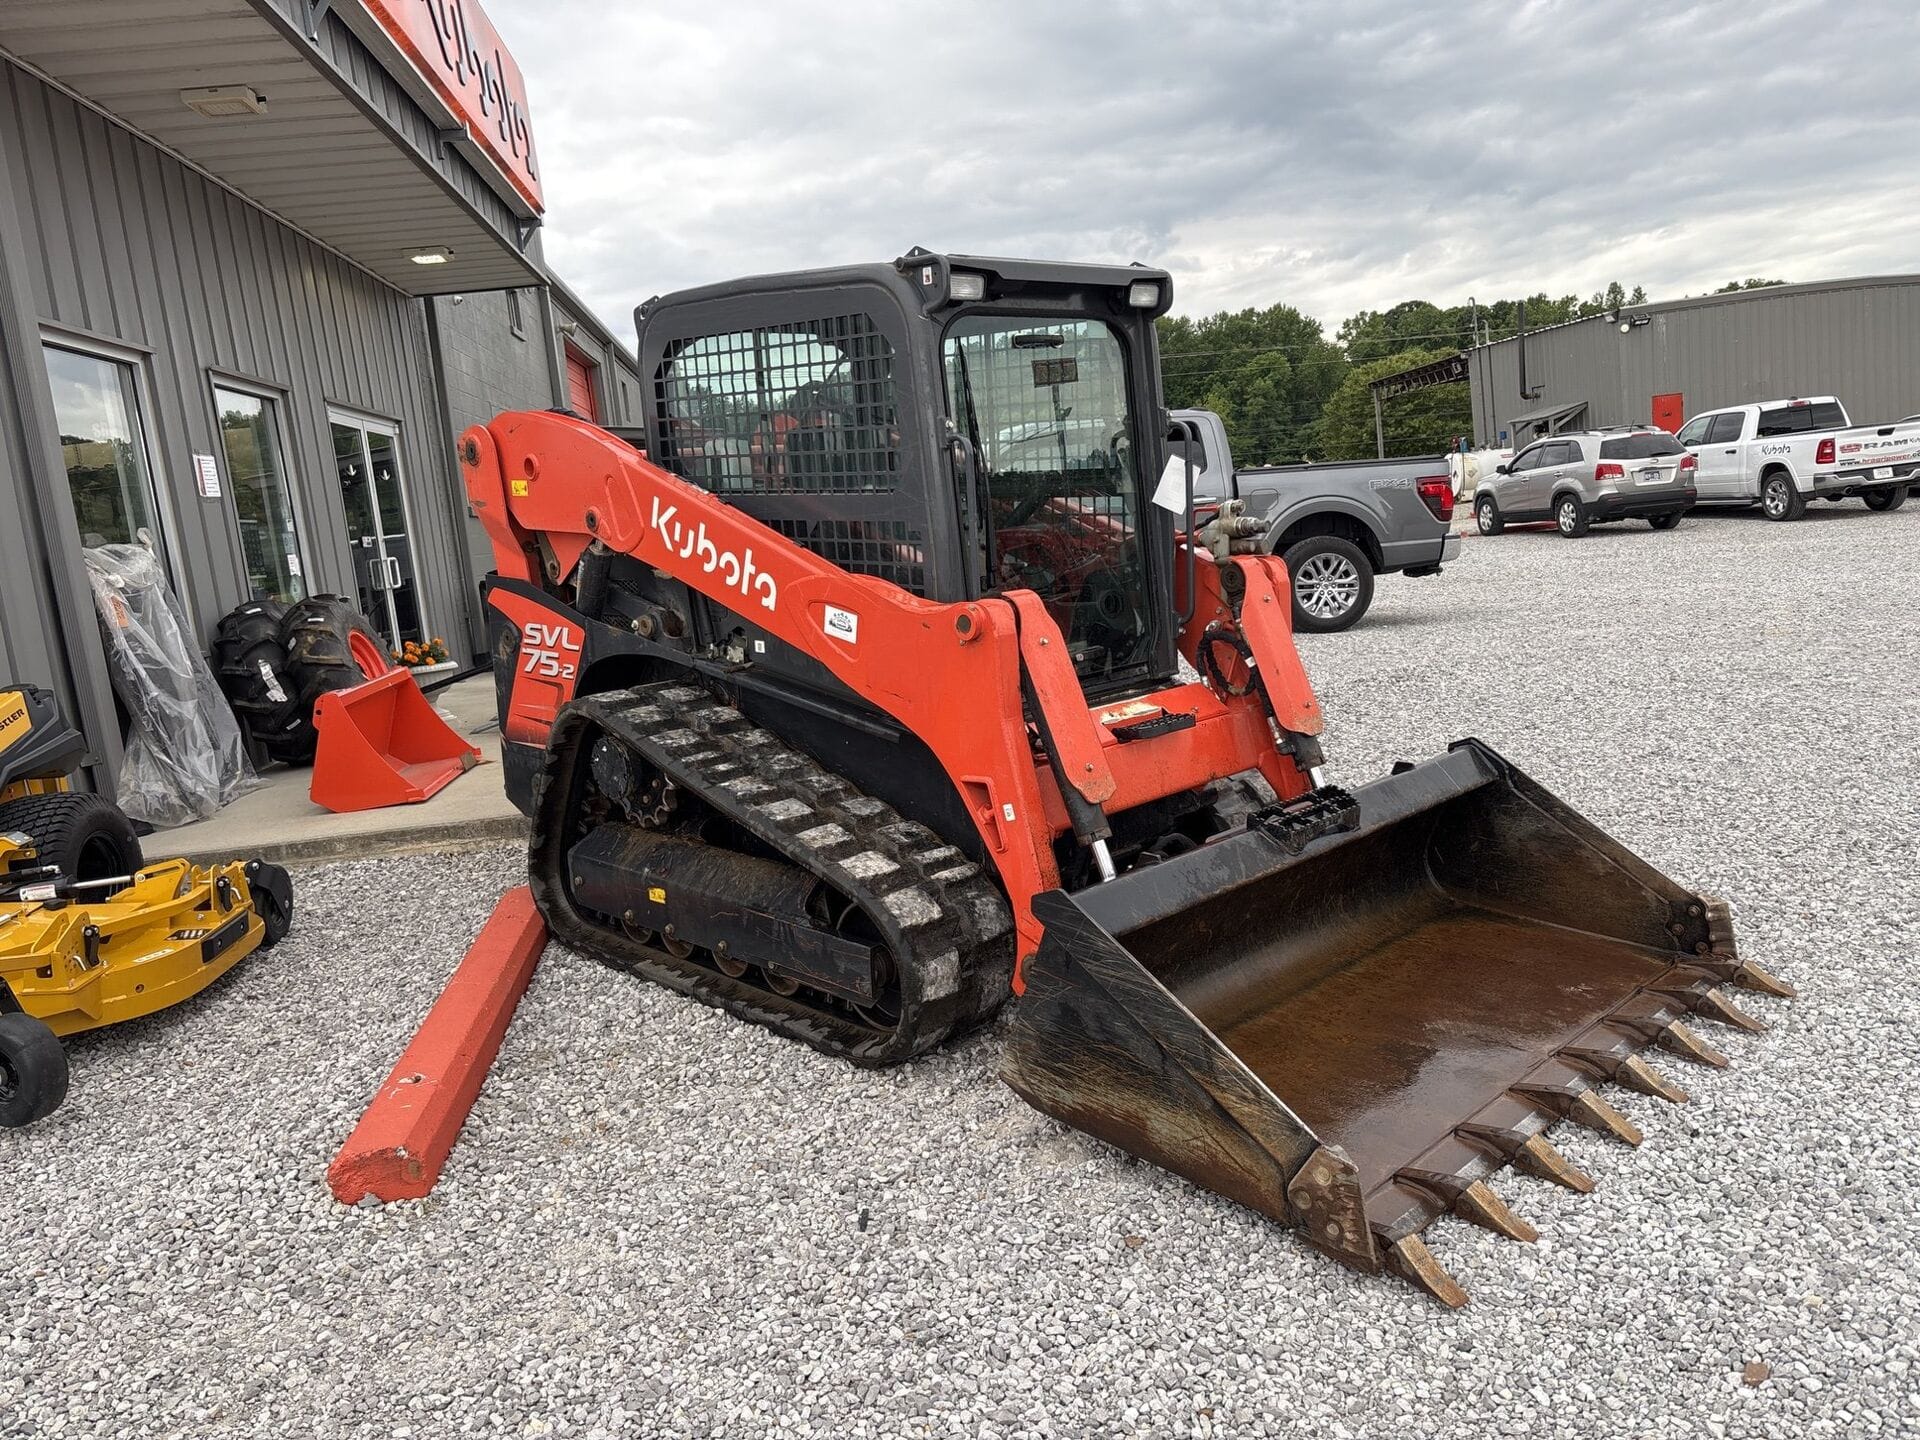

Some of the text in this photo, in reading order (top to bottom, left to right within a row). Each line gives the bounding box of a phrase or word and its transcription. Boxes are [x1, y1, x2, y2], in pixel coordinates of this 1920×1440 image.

[1761, 443, 1792, 456] Kubota
[1864, 439, 1908, 450] RAM
[651, 495, 777, 612] Kubota
[523, 622, 580, 652] SVL
[521, 647, 575, 680] 75-2
